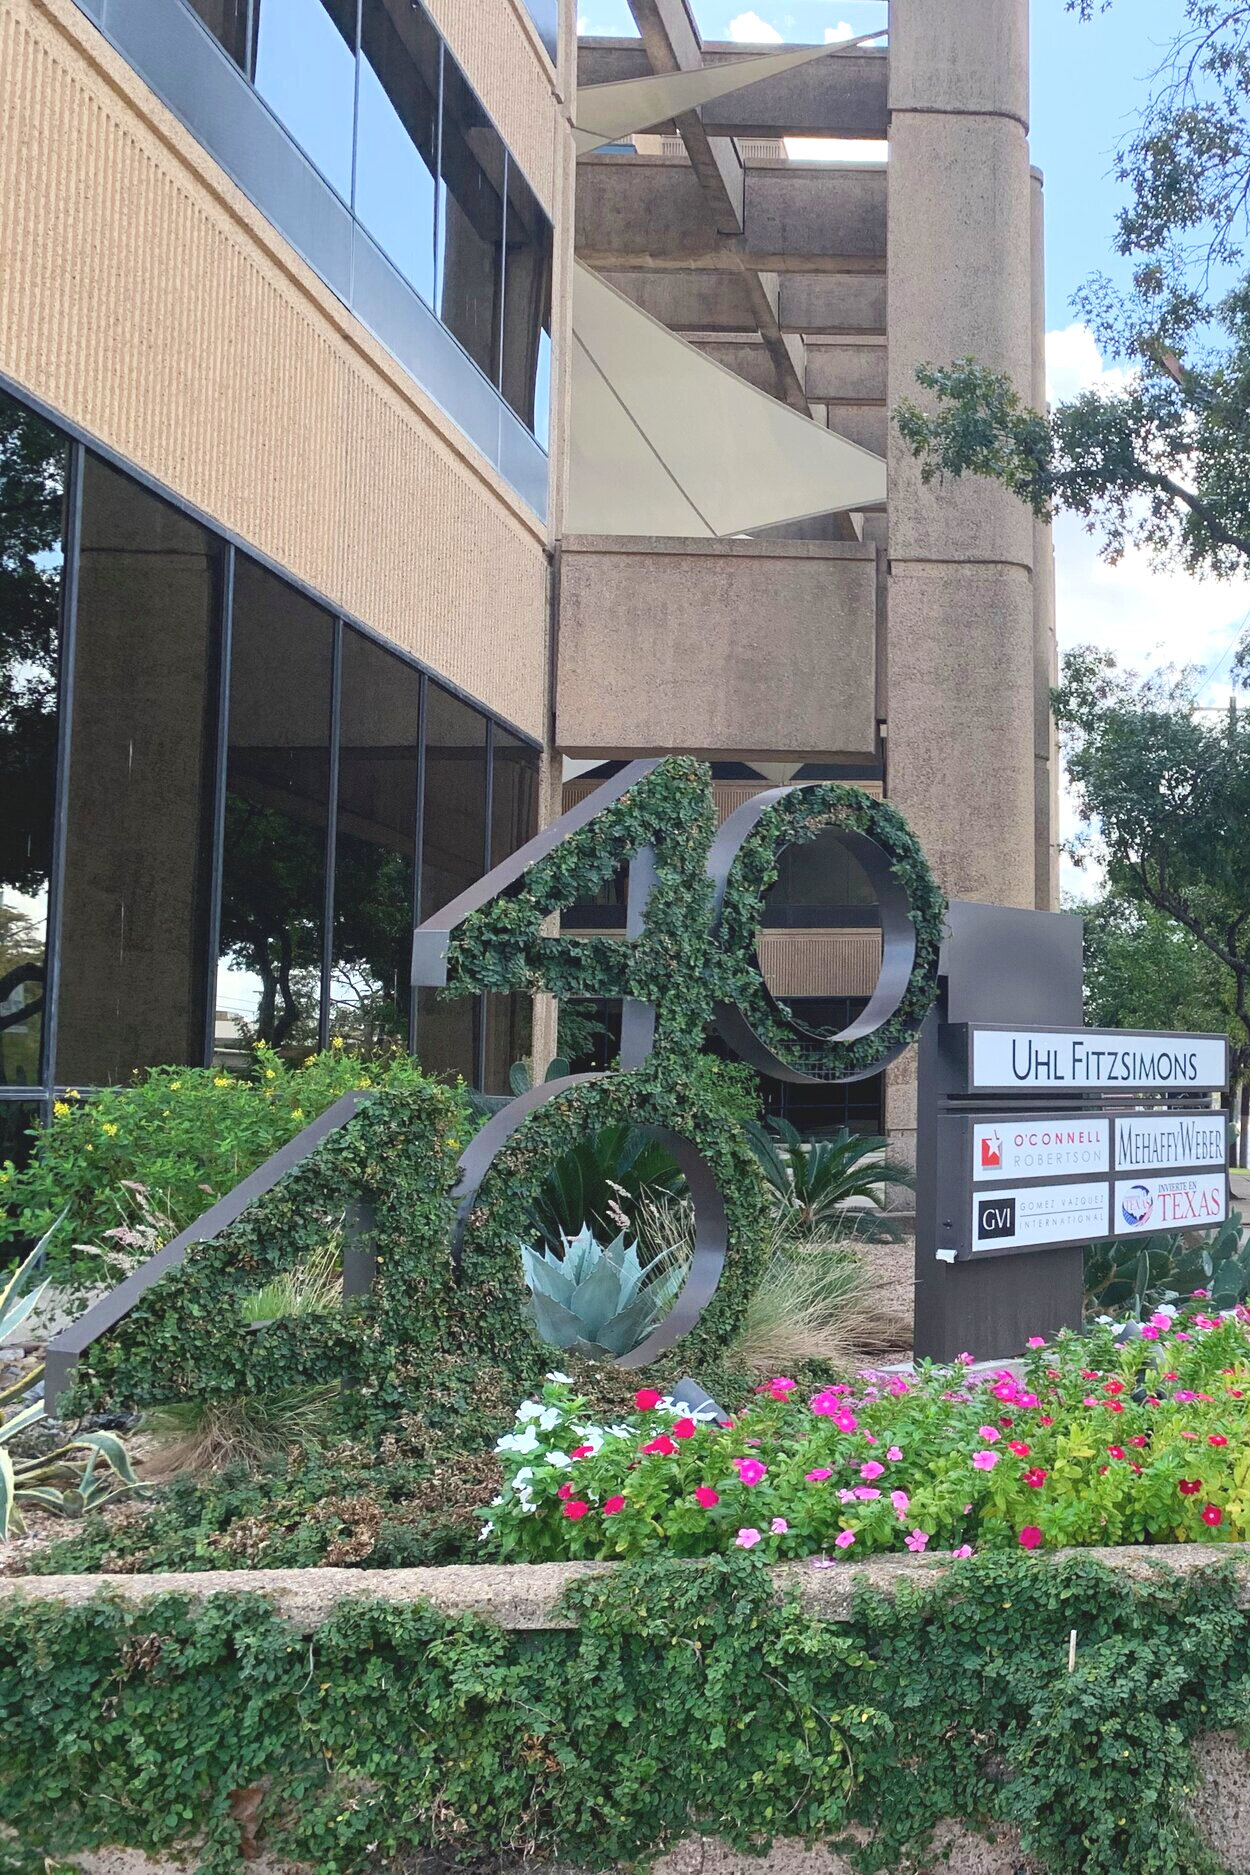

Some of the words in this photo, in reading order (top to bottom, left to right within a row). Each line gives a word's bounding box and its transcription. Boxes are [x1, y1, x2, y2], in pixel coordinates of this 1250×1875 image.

[1014, 1131, 1101, 1147] O'CONNELL
[1014, 1150, 1102, 1168] ROBERTSON
[1158, 1181, 1187, 1193] INVIERTE
[1189, 1181, 1197, 1190] EN
[1157, 1188, 1221, 1222] TEXAS
[982, 1207, 1011, 1230] GVI
[1019, 1213, 1104, 1231] INTERNATIONAL
